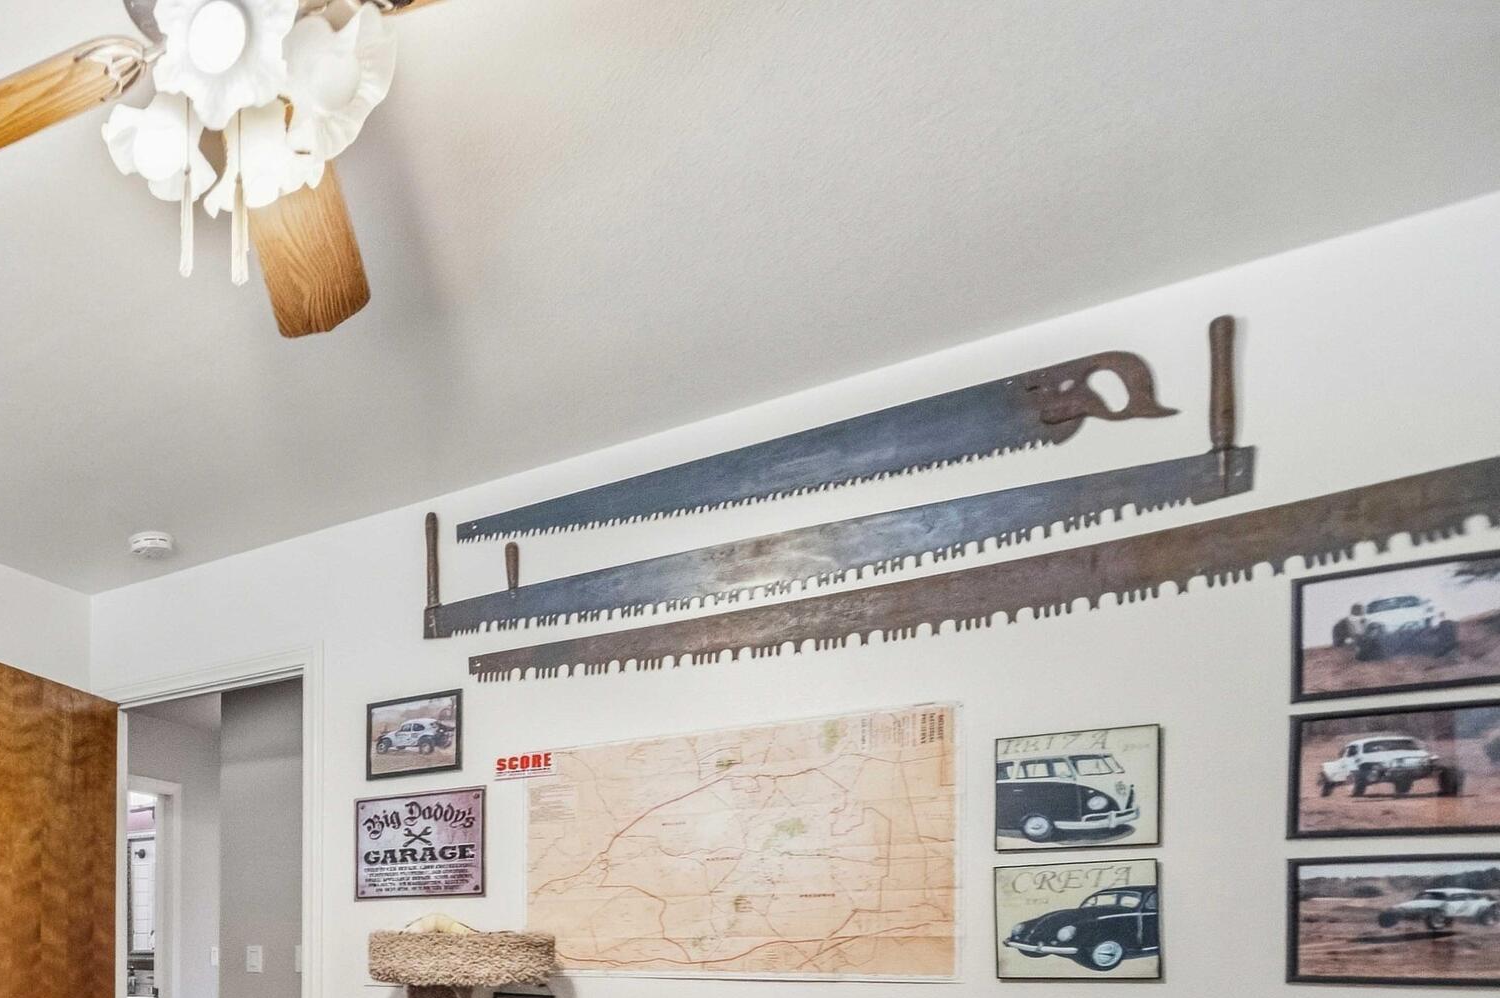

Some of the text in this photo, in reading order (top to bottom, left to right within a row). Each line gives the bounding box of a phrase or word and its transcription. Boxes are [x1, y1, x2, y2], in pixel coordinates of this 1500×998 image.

[495, 752, 552, 772] SCORE
[362, 801, 476, 840] Big Daddy's
[363, 844, 476, 865] GARAGE
[1011, 865, 1132, 894] CRETA
